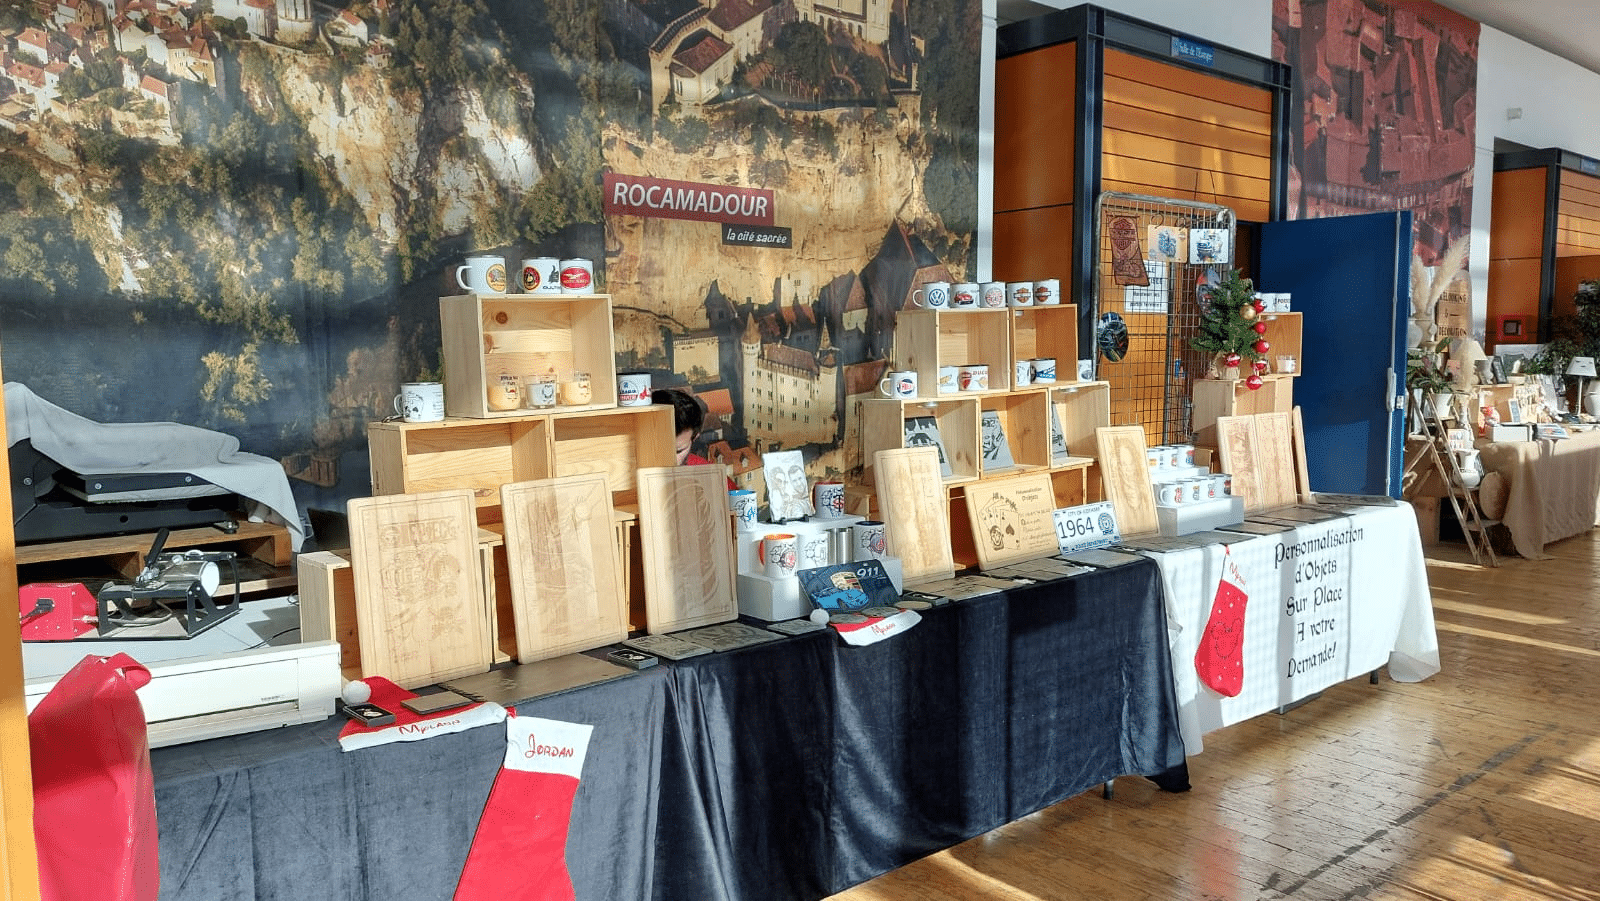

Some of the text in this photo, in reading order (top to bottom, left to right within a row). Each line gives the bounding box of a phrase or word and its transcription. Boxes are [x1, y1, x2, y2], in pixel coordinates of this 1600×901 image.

[613, 182, 767, 217] ROCAMADOUR
[726, 228, 787, 243] la cité sacrée
[1057, 516, 1095, 539] 1964
[1275, 528, 1363, 569] Personnalisation
[856, 566, 879, 578] 911
[1295, 557, 1337, 584] d'Objets
[1286, 585, 1342, 617] Sur Place
[1296, 621, 1305, 644] A
[1287, 641, 1337, 679] Demande!
